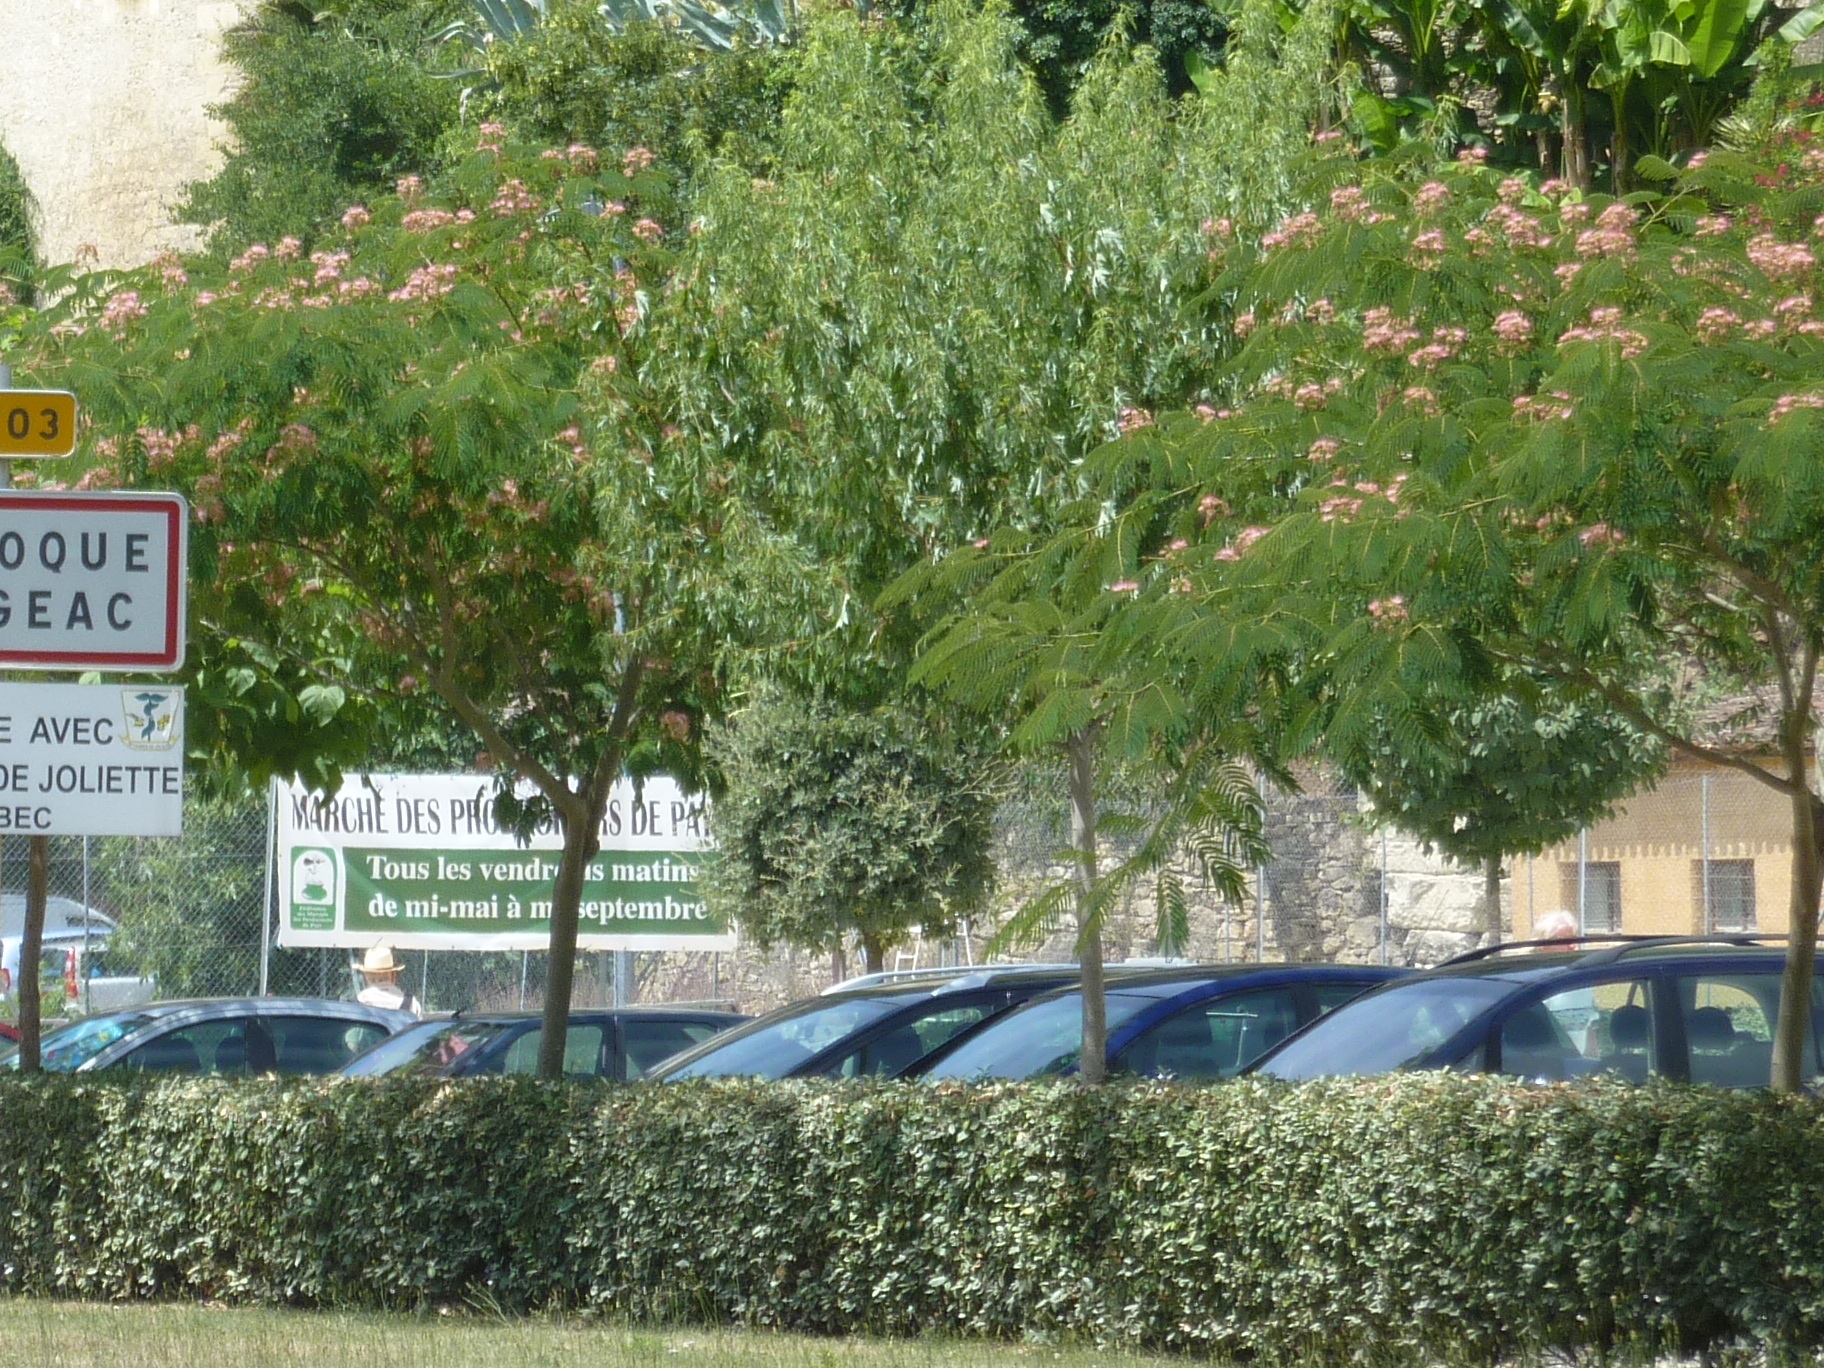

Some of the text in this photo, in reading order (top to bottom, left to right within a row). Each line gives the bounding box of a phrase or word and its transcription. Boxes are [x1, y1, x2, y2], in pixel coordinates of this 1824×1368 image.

[29, 717, 114, 745] AVEC
[38, 765, 179, 795] JOLIETTE
[396, 798, 441, 835] DES
[632, 800, 663, 836] DE
[366, 855, 430, 880] Tous
[437, 856, 471, 881] les
[612, 858, 700, 882] matins
[368, 893, 398, 918] de
[405, 893, 499, 918] mi-mai
[507, 893, 521, 919] à
